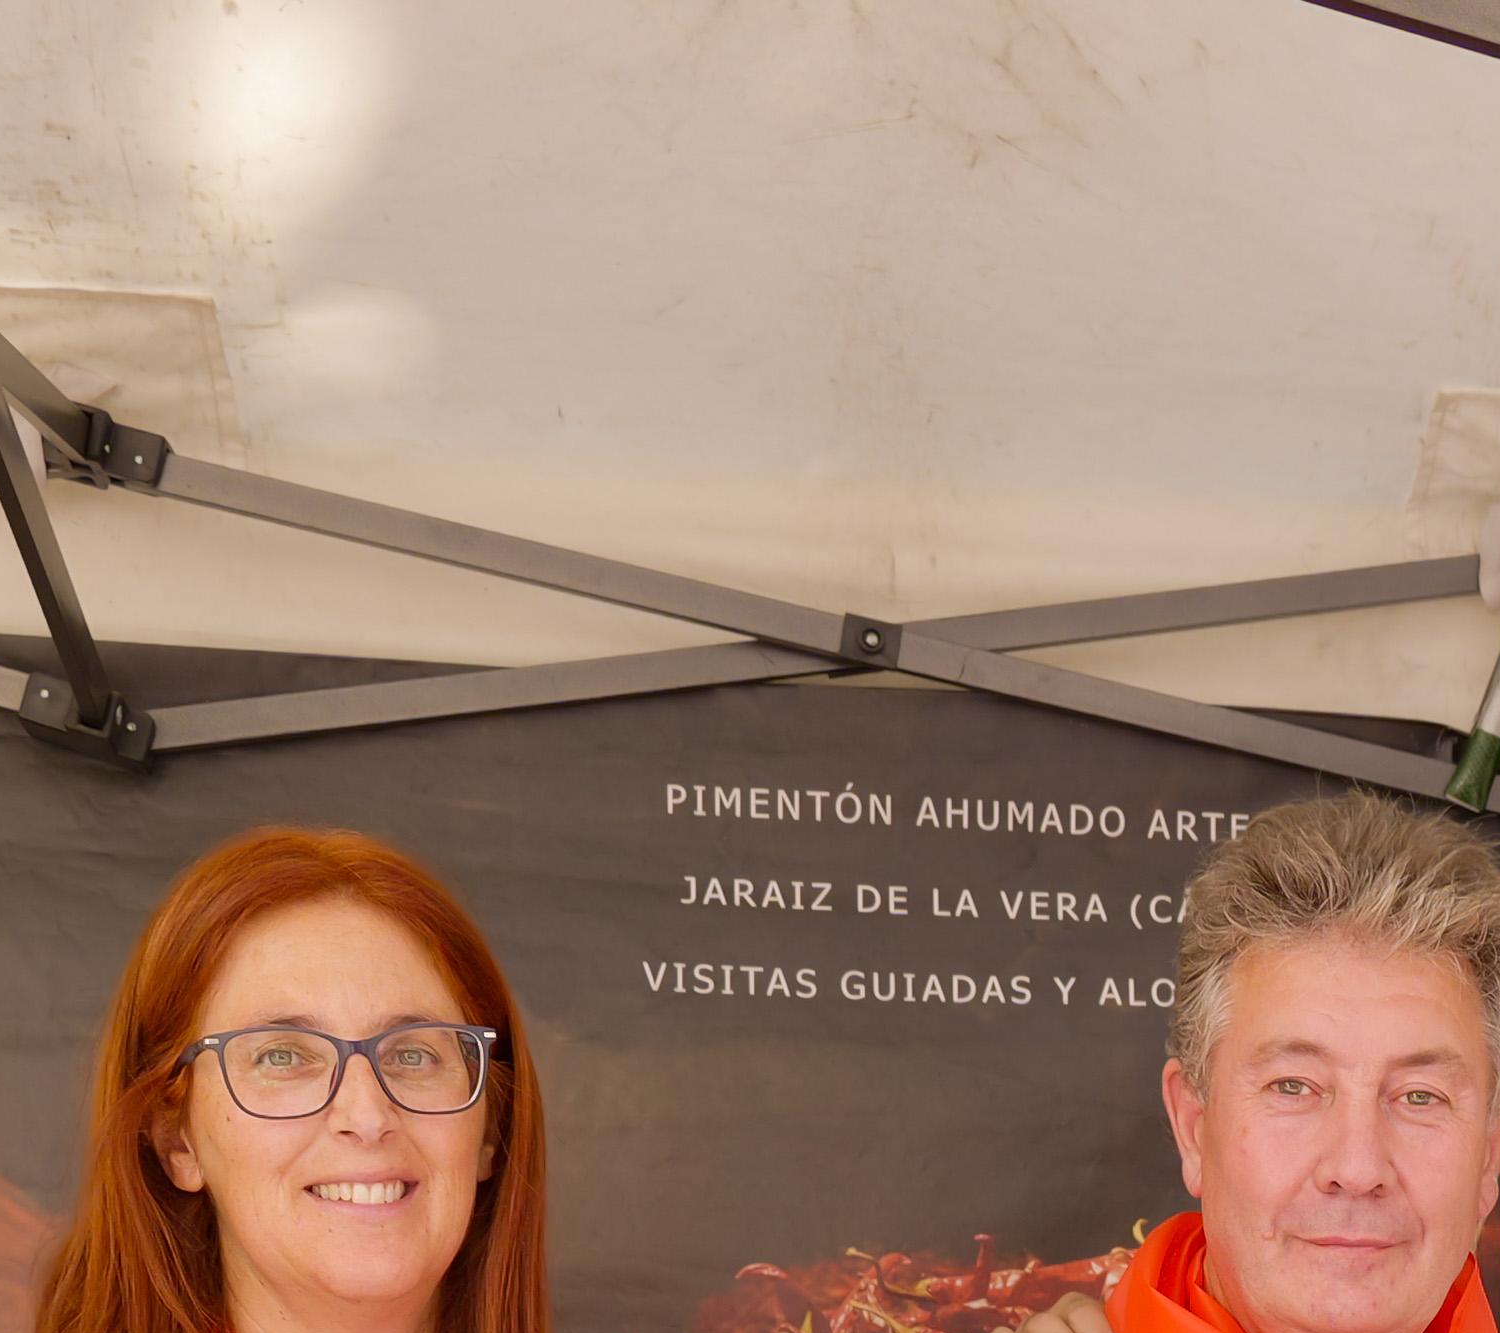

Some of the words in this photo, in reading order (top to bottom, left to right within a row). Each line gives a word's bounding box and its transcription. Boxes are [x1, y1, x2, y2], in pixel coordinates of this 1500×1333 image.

[666, 783, 894, 826] PIMENTÓN
[916, 797, 1127, 838] AHUMADO
[1147, 809, 1251, 843] ARTE
[680, 877, 832, 912] JARAIZ
[857, 887, 908, 914] DE
[932, 890, 978, 918] LA
[1001, 891, 1107, 923] VERA
[643, 961, 818, 998] VISITAS
[841, 970, 1032, 1004] GUIADAS
[1053, 978, 1076, 1005] Y
[1099, 978, 1175, 1007] ALO
